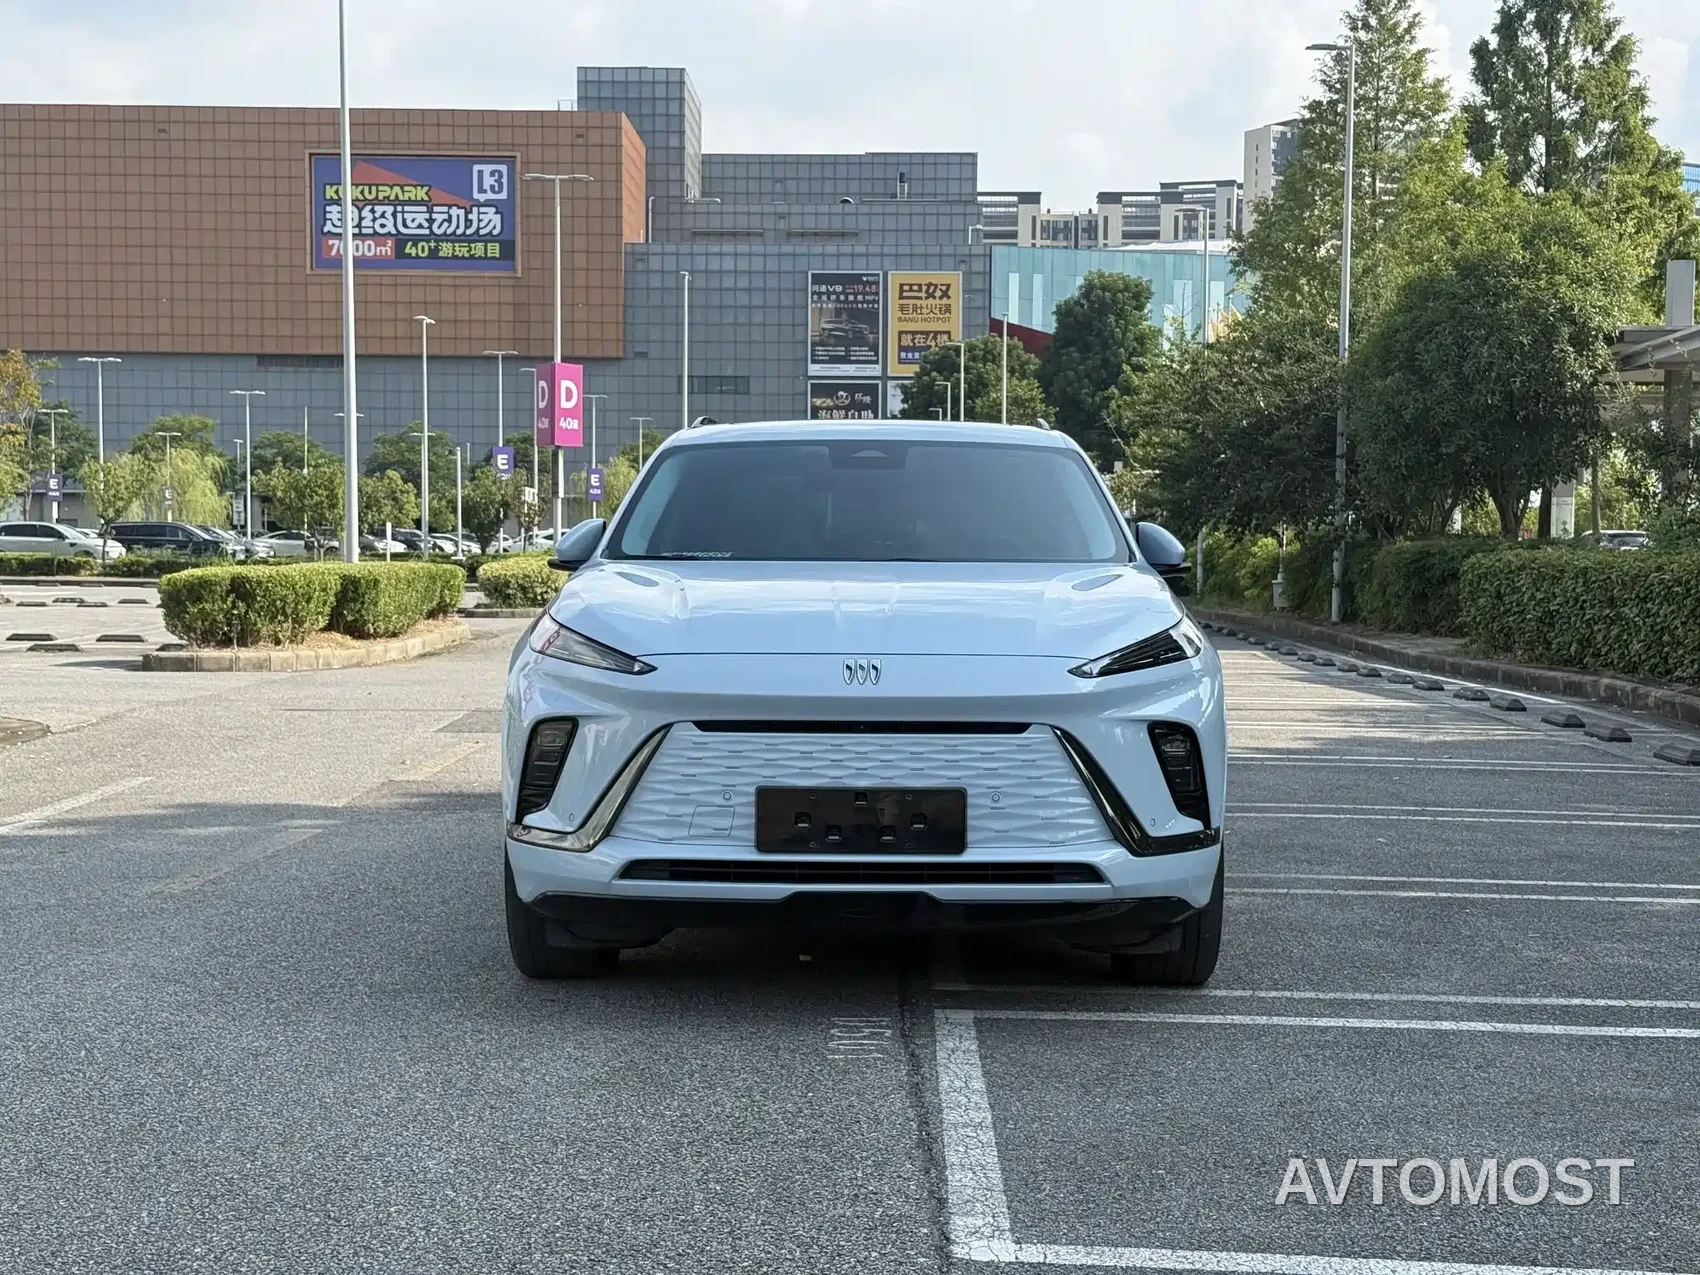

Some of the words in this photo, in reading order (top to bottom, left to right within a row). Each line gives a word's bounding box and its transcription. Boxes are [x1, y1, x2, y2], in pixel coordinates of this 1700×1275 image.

[477, 169, 504, 195] L3
[325, 185, 431, 200] KKUPARK
[323, 204, 502, 236] 超级运动场
[328, 239, 392, 257] 700m²
[898, 281, 951, 301] 巴奴
[897, 303, 951, 315] 毛肚火锅
[538, 380, 549, 409] D
[560, 379, 578, 409] D
[497, 454, 509, 470] E
[49, 478, 59, 490] E
[590, 474, 600, 486] E
